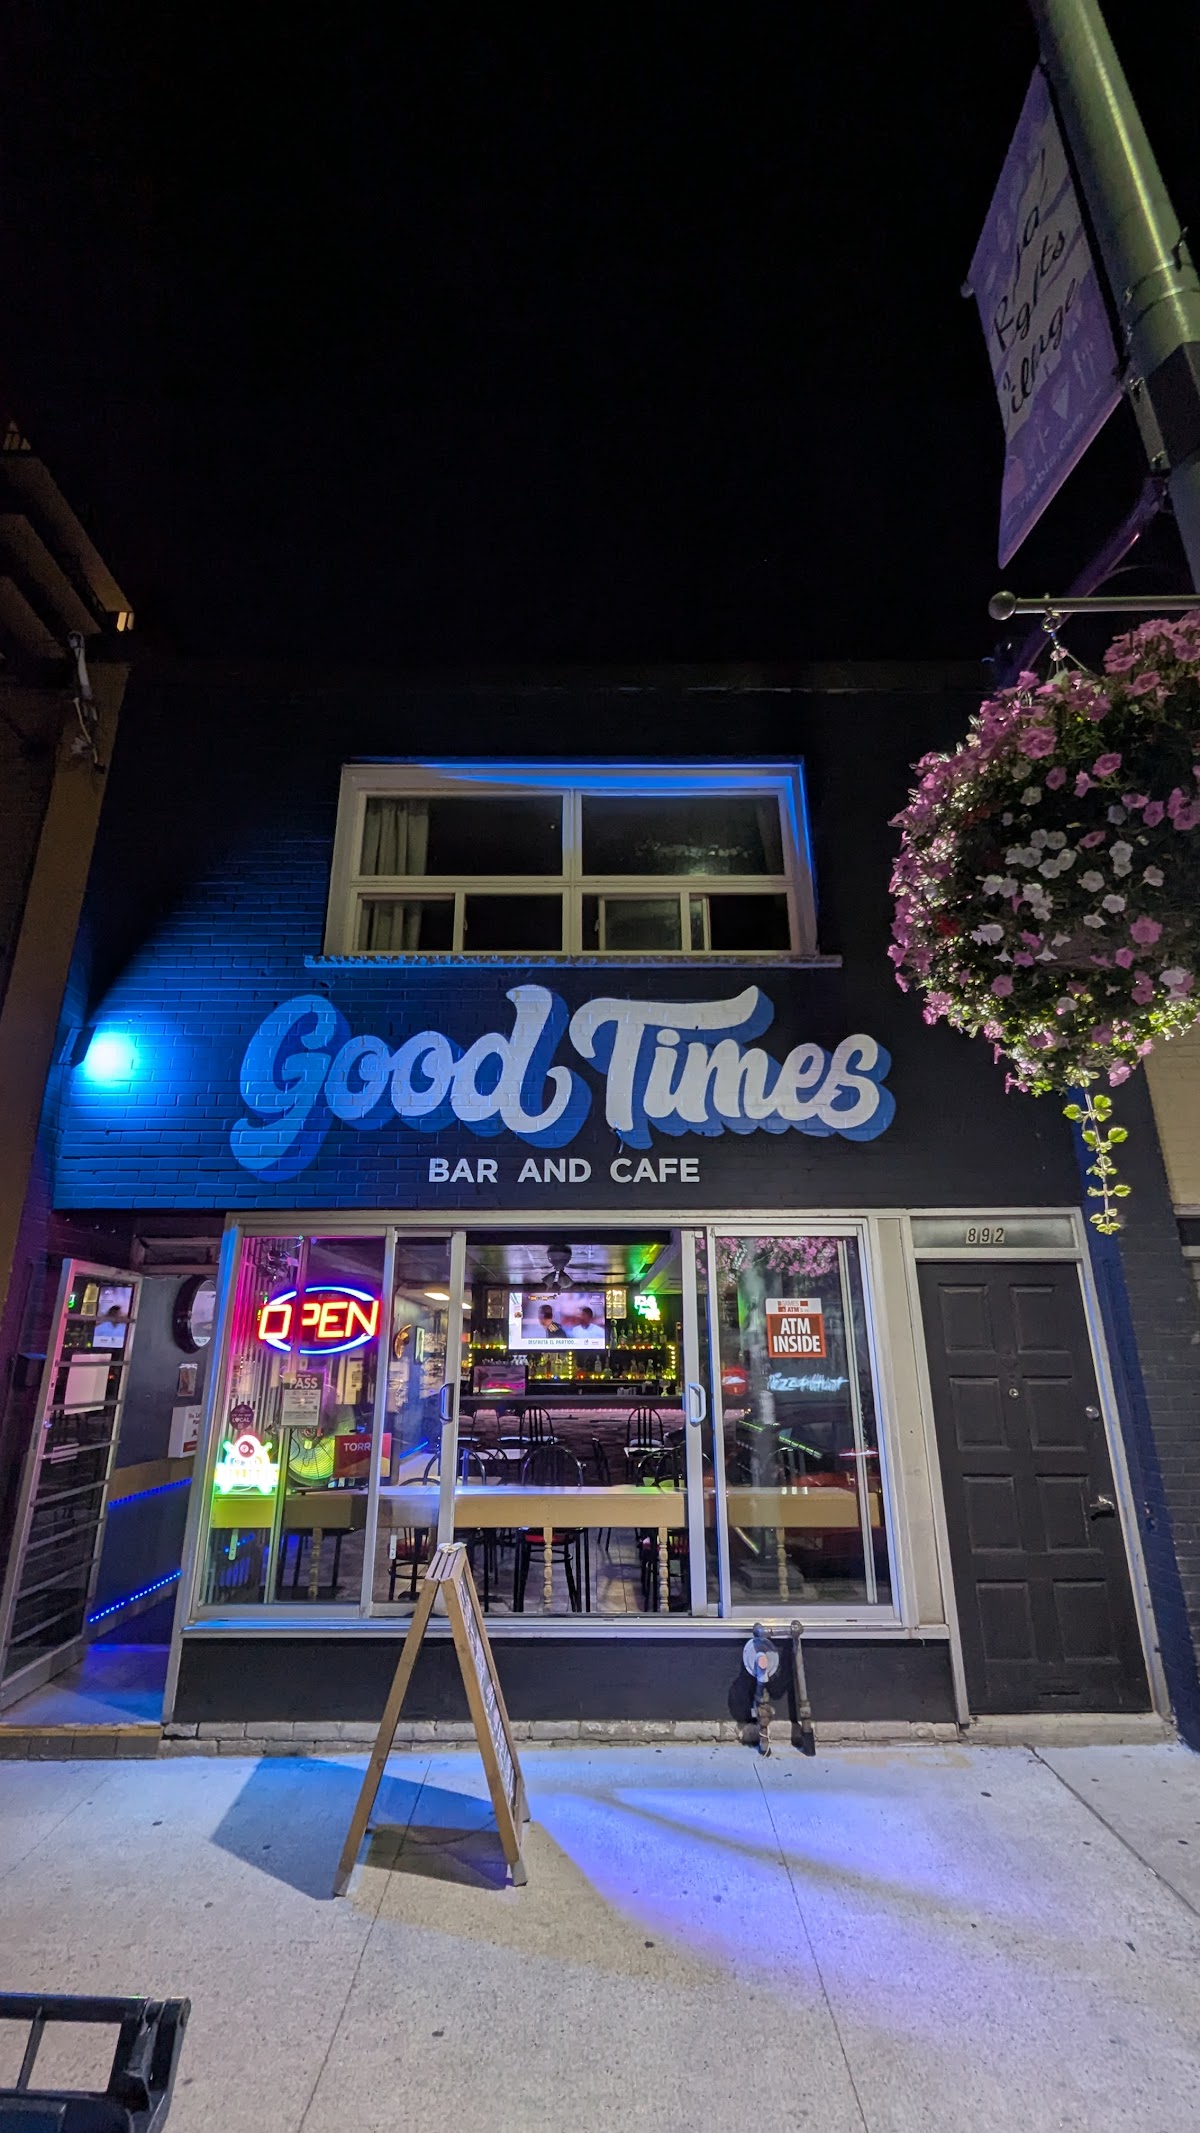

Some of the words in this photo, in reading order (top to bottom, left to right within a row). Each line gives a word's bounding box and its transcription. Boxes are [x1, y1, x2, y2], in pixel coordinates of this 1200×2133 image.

[230, 984, 574, 1170] Good
[569, 985, 882, 1133] Times
[428, 1158, 498, 1183] BAR
[518, 1158, 591, 1183] AND
[610, 1158, 699, 1183] CAFE
[967, 1227, 1004, 1243] 892
[258, 1300, 380, 1340] OPEN
[780, 1318, 811, 1334] ATM
[773, 1335, 821, 1352] INSIDE
[289, 1377, 318, 1389] PASS
[343, 1442, 371, 1452] TORR
